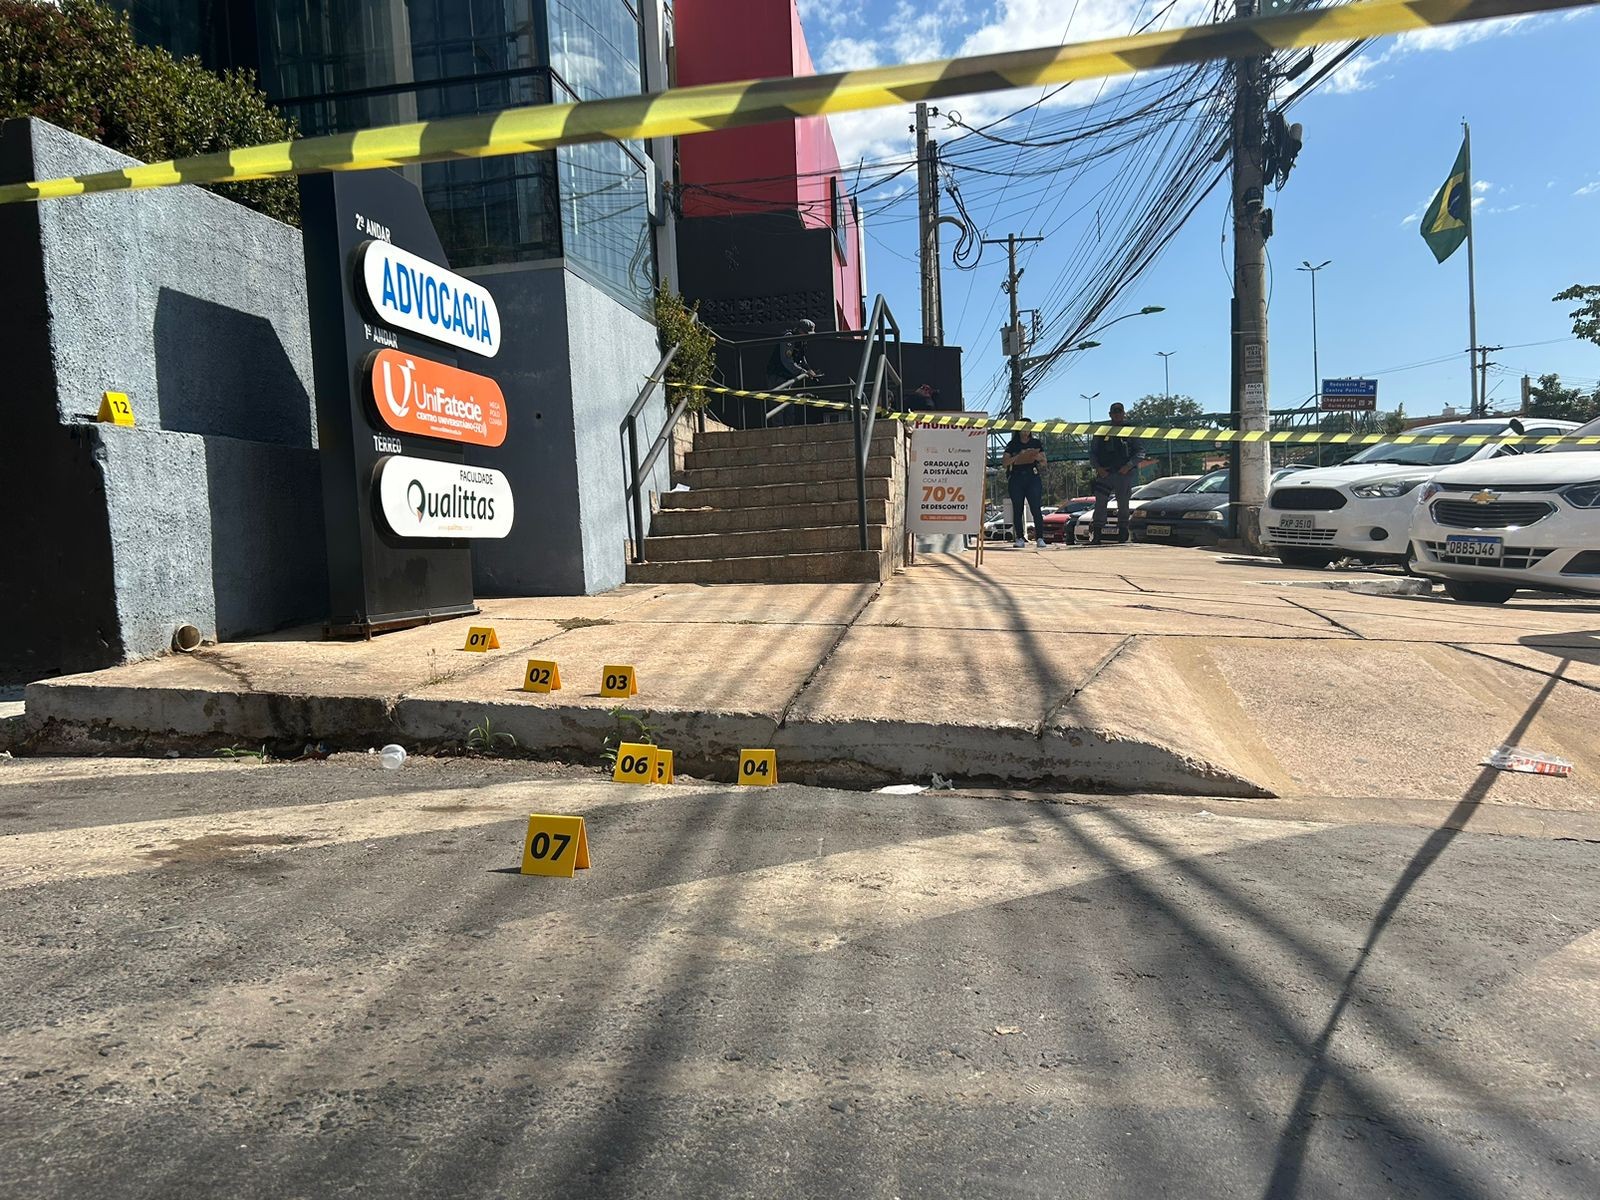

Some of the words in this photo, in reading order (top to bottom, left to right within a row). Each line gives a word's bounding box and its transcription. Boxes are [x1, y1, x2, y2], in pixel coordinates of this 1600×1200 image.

[366, 218, 391, 244] ANDAR
[382, 257, 492, 346] ADVOCACIA
[373, 326, 398, 349] ANDAR
[113, 401, 129, 414] 12
[414, 381, 482, 422] UniFatecie
[416, 411, 437, 423] CENTRO
[373, 433, 401, 453] TÉRREO
[923, 460, 970, 469] GRADUAÇÃO
[929, 467, 968, 475] DISTÂNCIA
[460, 470, 493, 485] FACULDADE
[407, 479, 495, 522] Qualittas
[922, 486, 965, 502] 70%
[470, 633, 487, 646] 01
[529, 668, 550, 685] 02
[605, 674, 628, 690] 03
[620, 755, 648, 775] 06
[743, 759, 768, 776] 04
[530, 832, 571, 861] 07
